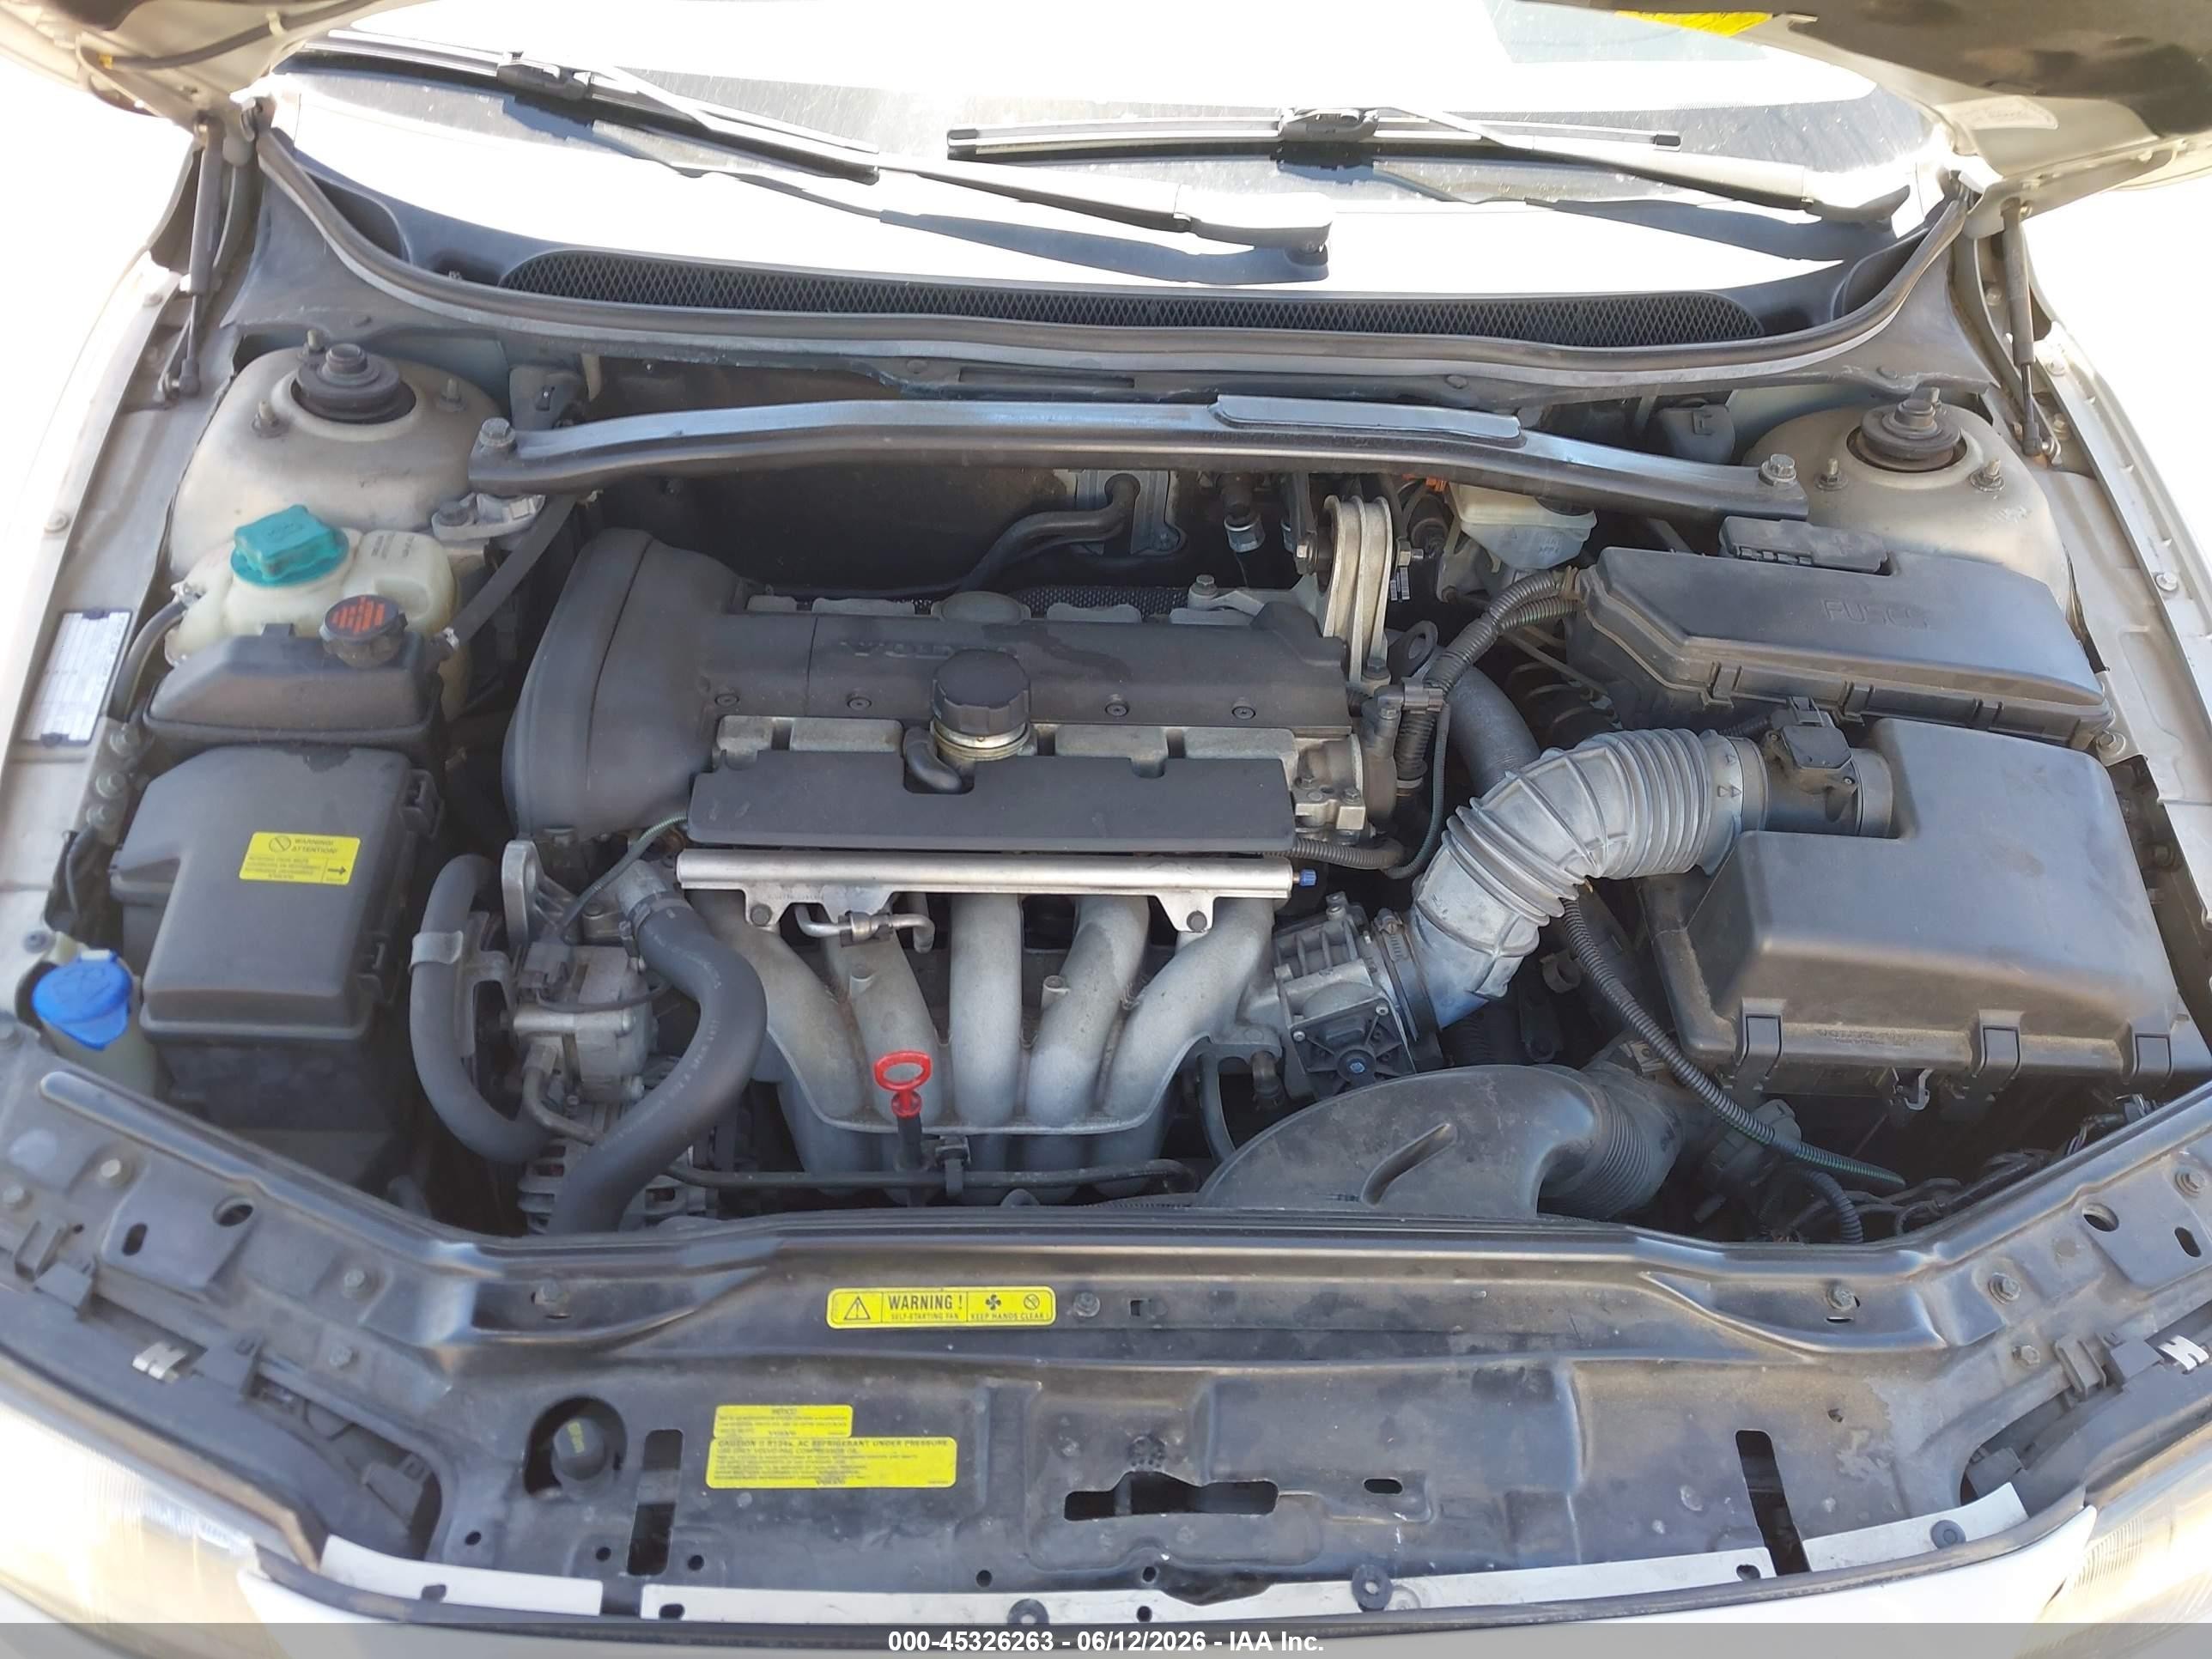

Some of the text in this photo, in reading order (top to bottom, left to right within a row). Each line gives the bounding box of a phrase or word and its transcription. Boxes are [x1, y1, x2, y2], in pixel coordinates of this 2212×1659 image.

[887, 1294, 953, 1310] WARNING
[970, 1312, 989, 1321] KEEP
[991, 1312, 1018, 1321] HANDS
